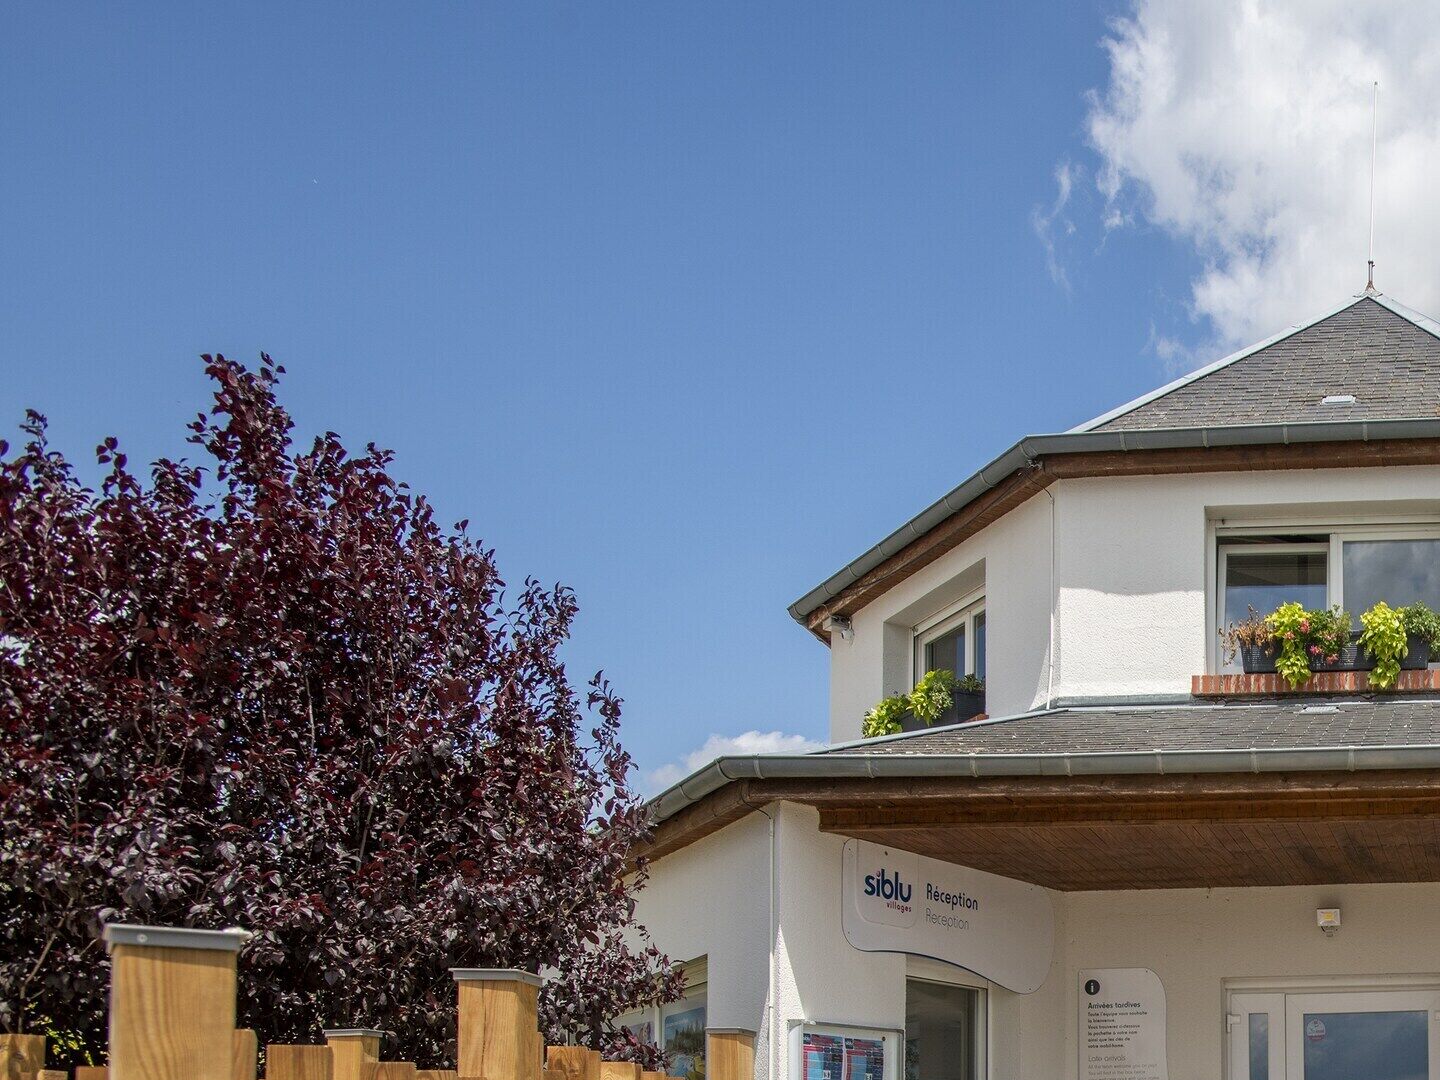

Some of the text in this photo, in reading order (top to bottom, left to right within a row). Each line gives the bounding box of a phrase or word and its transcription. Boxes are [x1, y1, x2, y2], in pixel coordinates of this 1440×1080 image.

[864, 868, 912, 902] siblu
[926, 883, 978, 910] Réception
[886, 900, 912, 913] villages
[926, 907, 969, 931] Reception
